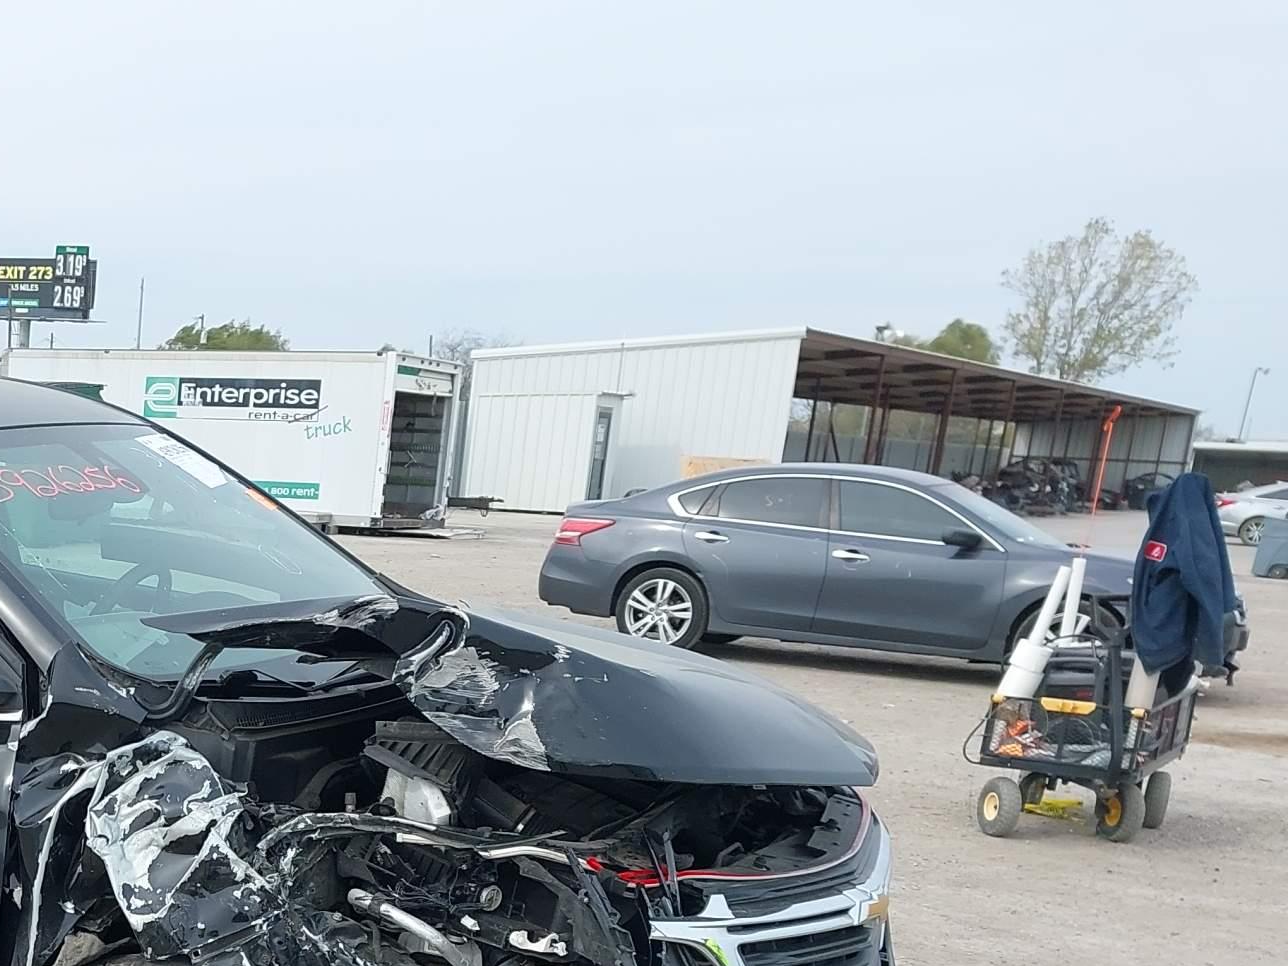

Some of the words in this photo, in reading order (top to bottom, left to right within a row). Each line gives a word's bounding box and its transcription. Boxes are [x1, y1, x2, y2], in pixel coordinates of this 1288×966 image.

[28, 266, 53, 280] 273
[181, 383, 319, 408] Enterprise
[248, 411, 314, 421] rent-a-car
[304, 416, 352, 440] truck
[270, 487, 289, 496] 800
